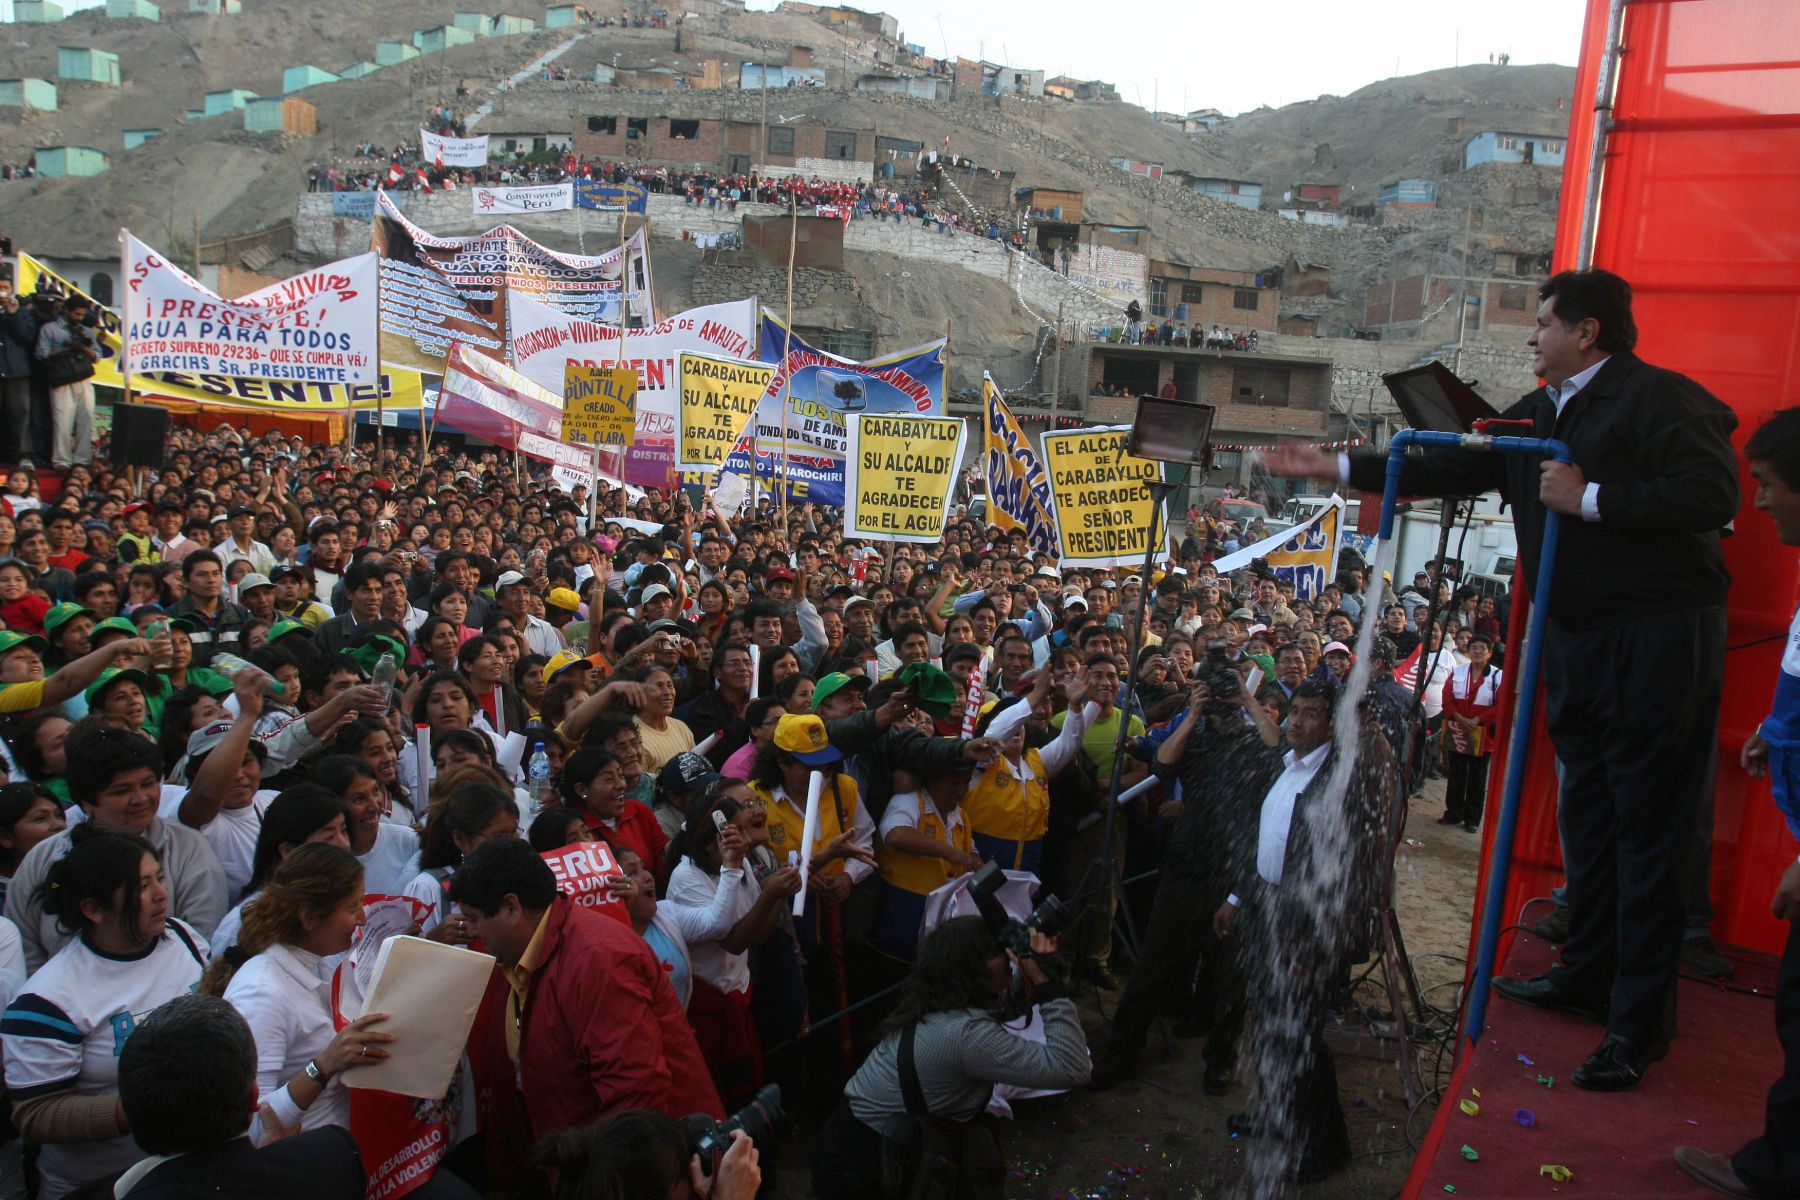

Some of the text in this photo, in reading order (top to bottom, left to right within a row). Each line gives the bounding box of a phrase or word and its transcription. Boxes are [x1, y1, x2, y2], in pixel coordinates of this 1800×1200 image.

[506, 189, 568, 201] Construyendo
[464, 241, 480, 254] DE
[480, 263, 521, 274] PARA
[448, 276, 504, 286] UEBLOS
[678, 318, 695, 331] DE
[130, 320, 352, 351] AGUA PARA TODOS
[130, 340, 166, 357] ECRETO
[170, 340, 220, 357] SUPREMO
[269, 348, 290, 364] QUE
[292, 350, 304, 364] SE
[306, 351, 344, 367] CUMPLA
[141, 355, 347, 382] GRACIAS SR. PRESIDENTE
[683, 359, 771, 386] CARABAYLLO
[564, 379, 636, 414] PUNTILLA
[721, 384, 729, 392] Y
[683, 388, 701, 407] SU
[713, 413, 732, 428] TE
[803, 418, 821, 433] DE
[864, 418, 958, 441] CARABAYLLO
[594, 431, 625, 446] CLARA
[824, 438, 838, 451] DE
[904, 441, 912, 452] Y
[686, 448, 701, 460] POR
[704, 445, 723, 461] LA
[1055, 440, 1074, 456] EL
[863, 451, 951, 475] SU ALCALDE
[1095, 455, 1111, 465] DE
[1055, 462, 1155, 486] CARABAYLLO
[895, 476, 916, 491] TE
[861, 491, 944, 510] AGRADECEN
[1056, 484, 1153, 508] TE AGRADEC
[858, 512, 941, 532] POR EL AGUA
[1083, 507, 1134, 529] SEÑOR
[544, 843, 612, 880] ERÚ
[379, 1129, 442, 1179] DESARROLLO
